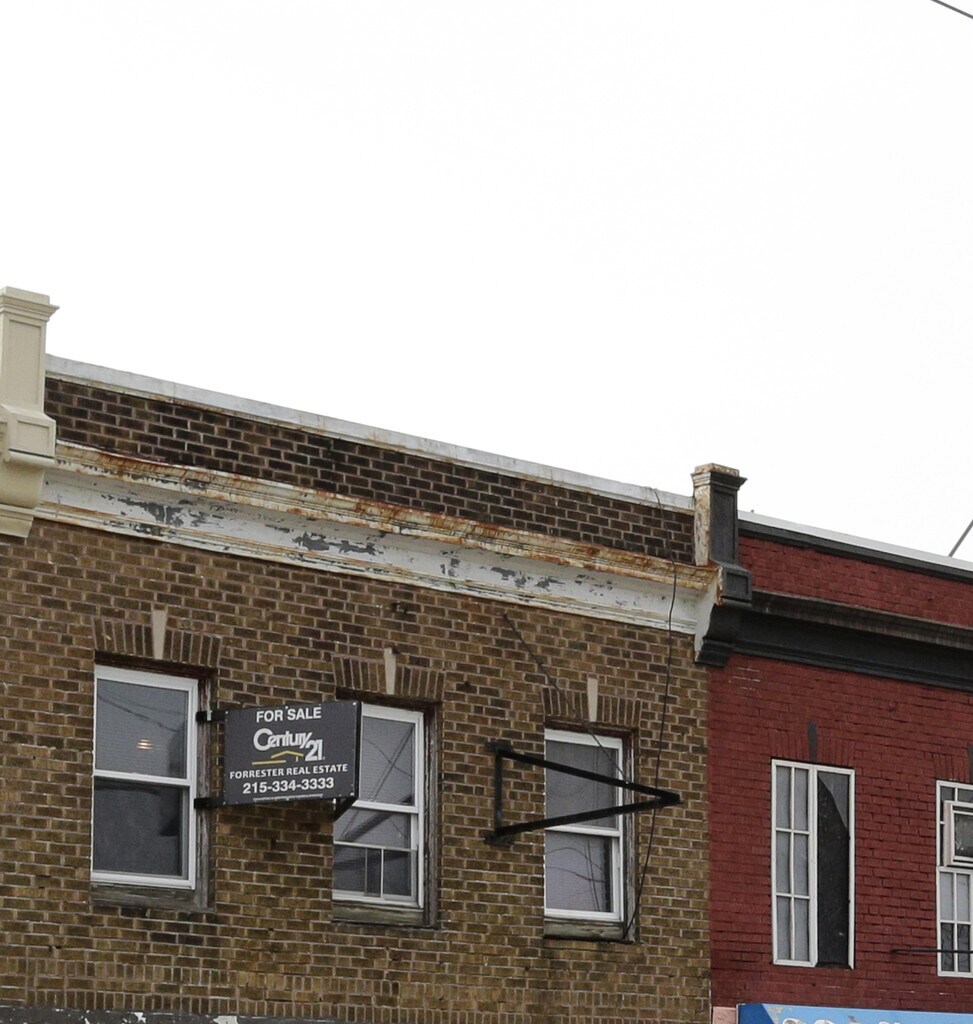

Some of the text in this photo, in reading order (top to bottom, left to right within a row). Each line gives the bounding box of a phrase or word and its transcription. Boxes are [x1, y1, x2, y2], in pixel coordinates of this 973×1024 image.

[256, 707, 321, 722] FOR SALE
[253, 728, 323, 761] Century 21
[230, 763, 348, 779] FORRESTER REAL ESTATE
[243, 777, 334, 794] 215-334-3333
